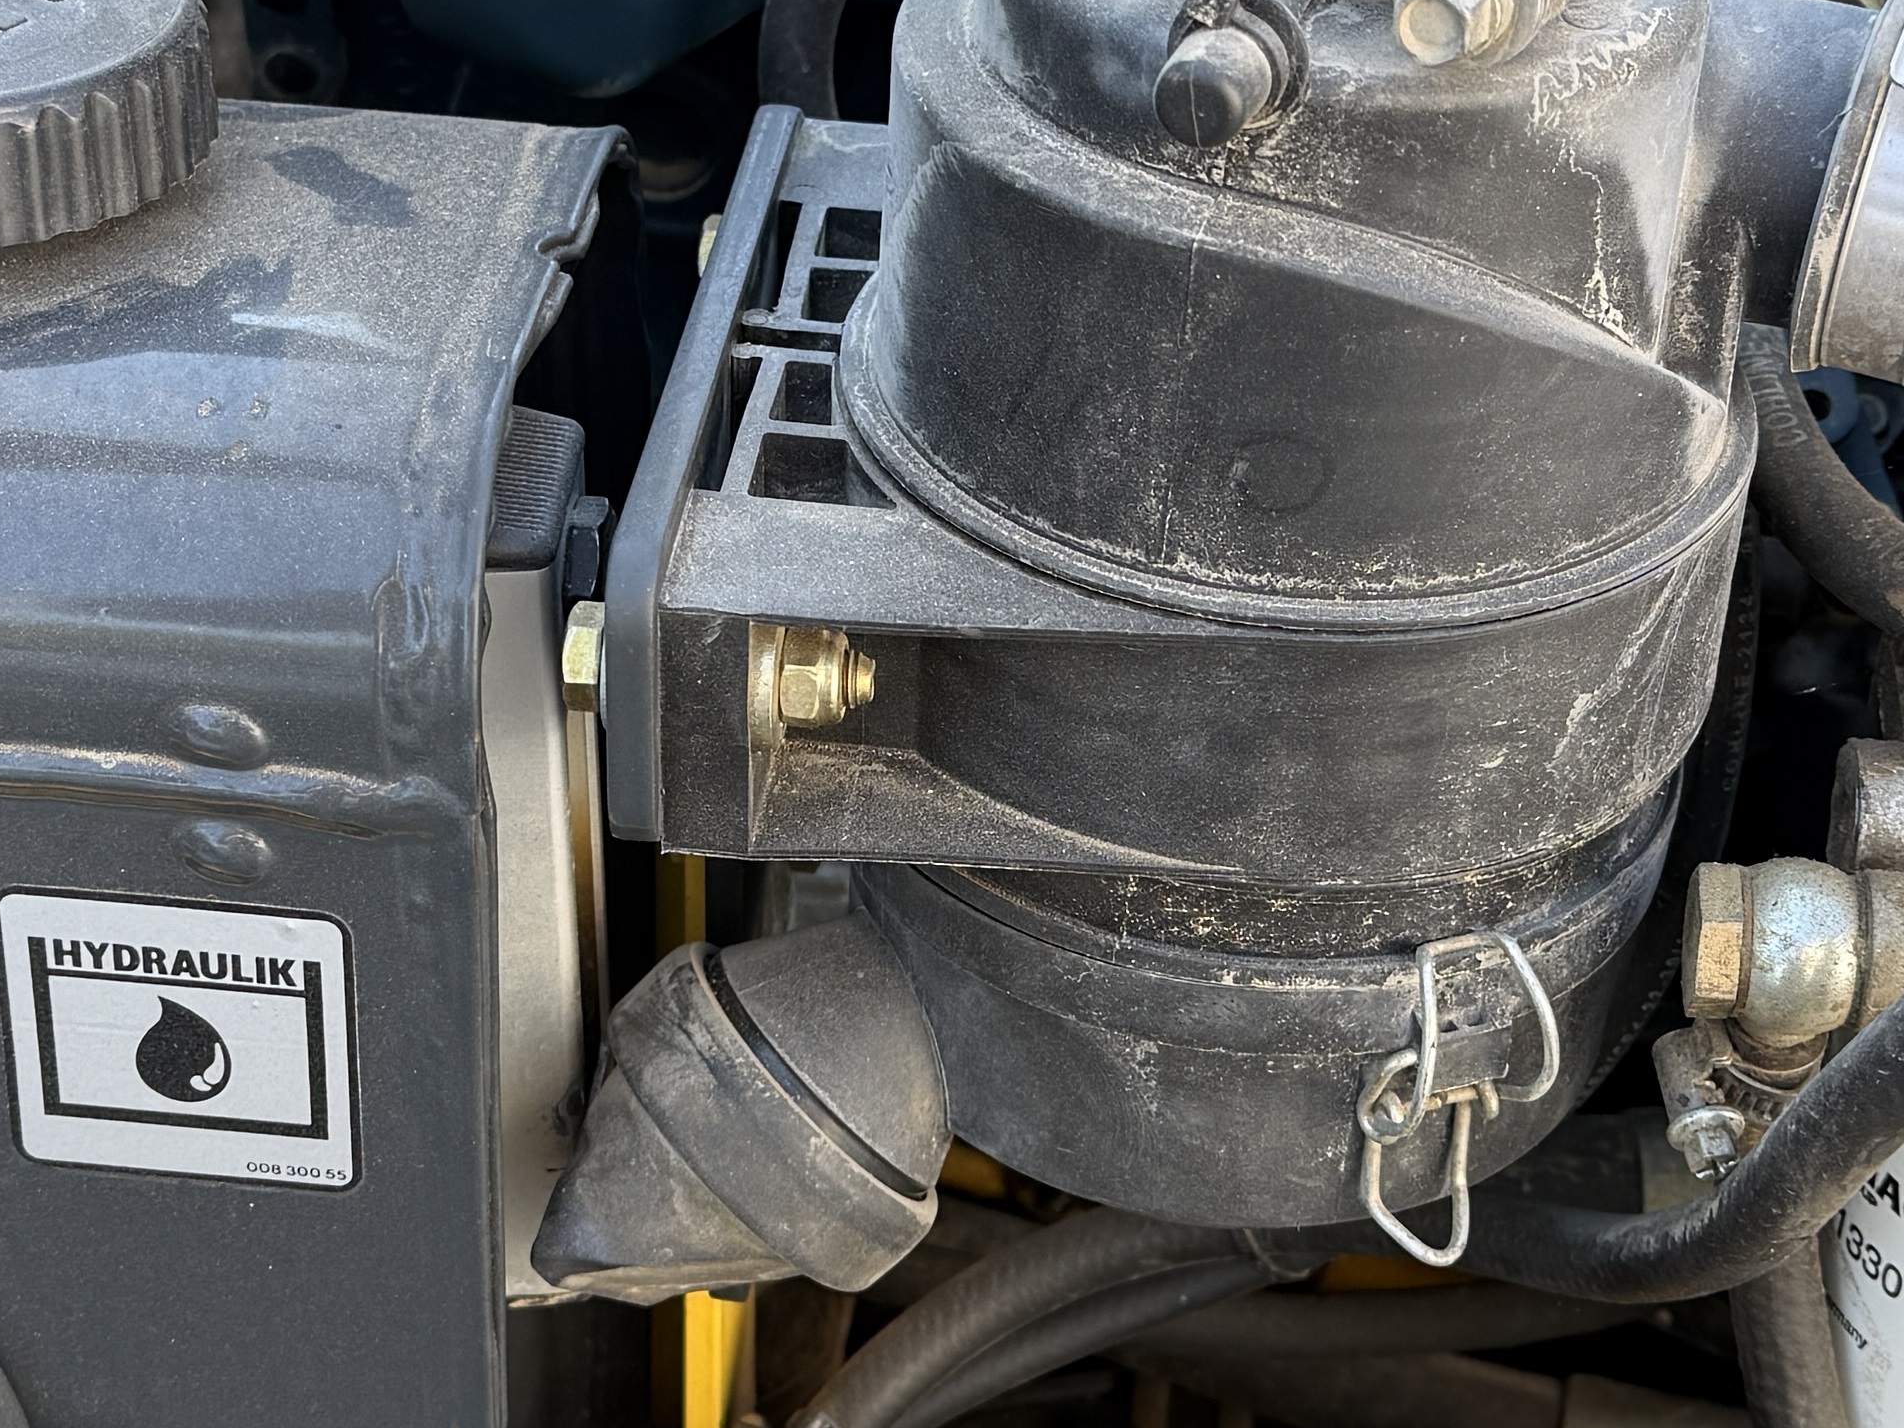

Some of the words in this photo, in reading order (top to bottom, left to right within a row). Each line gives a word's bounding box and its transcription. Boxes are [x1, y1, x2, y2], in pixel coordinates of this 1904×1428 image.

[52, 937, 298, 988] HYDRAULIK
[245, 1160, 283, 1176] 008
[285, 1164, 322, 1180] 300
[325, 1167, 348, 1181] 55
